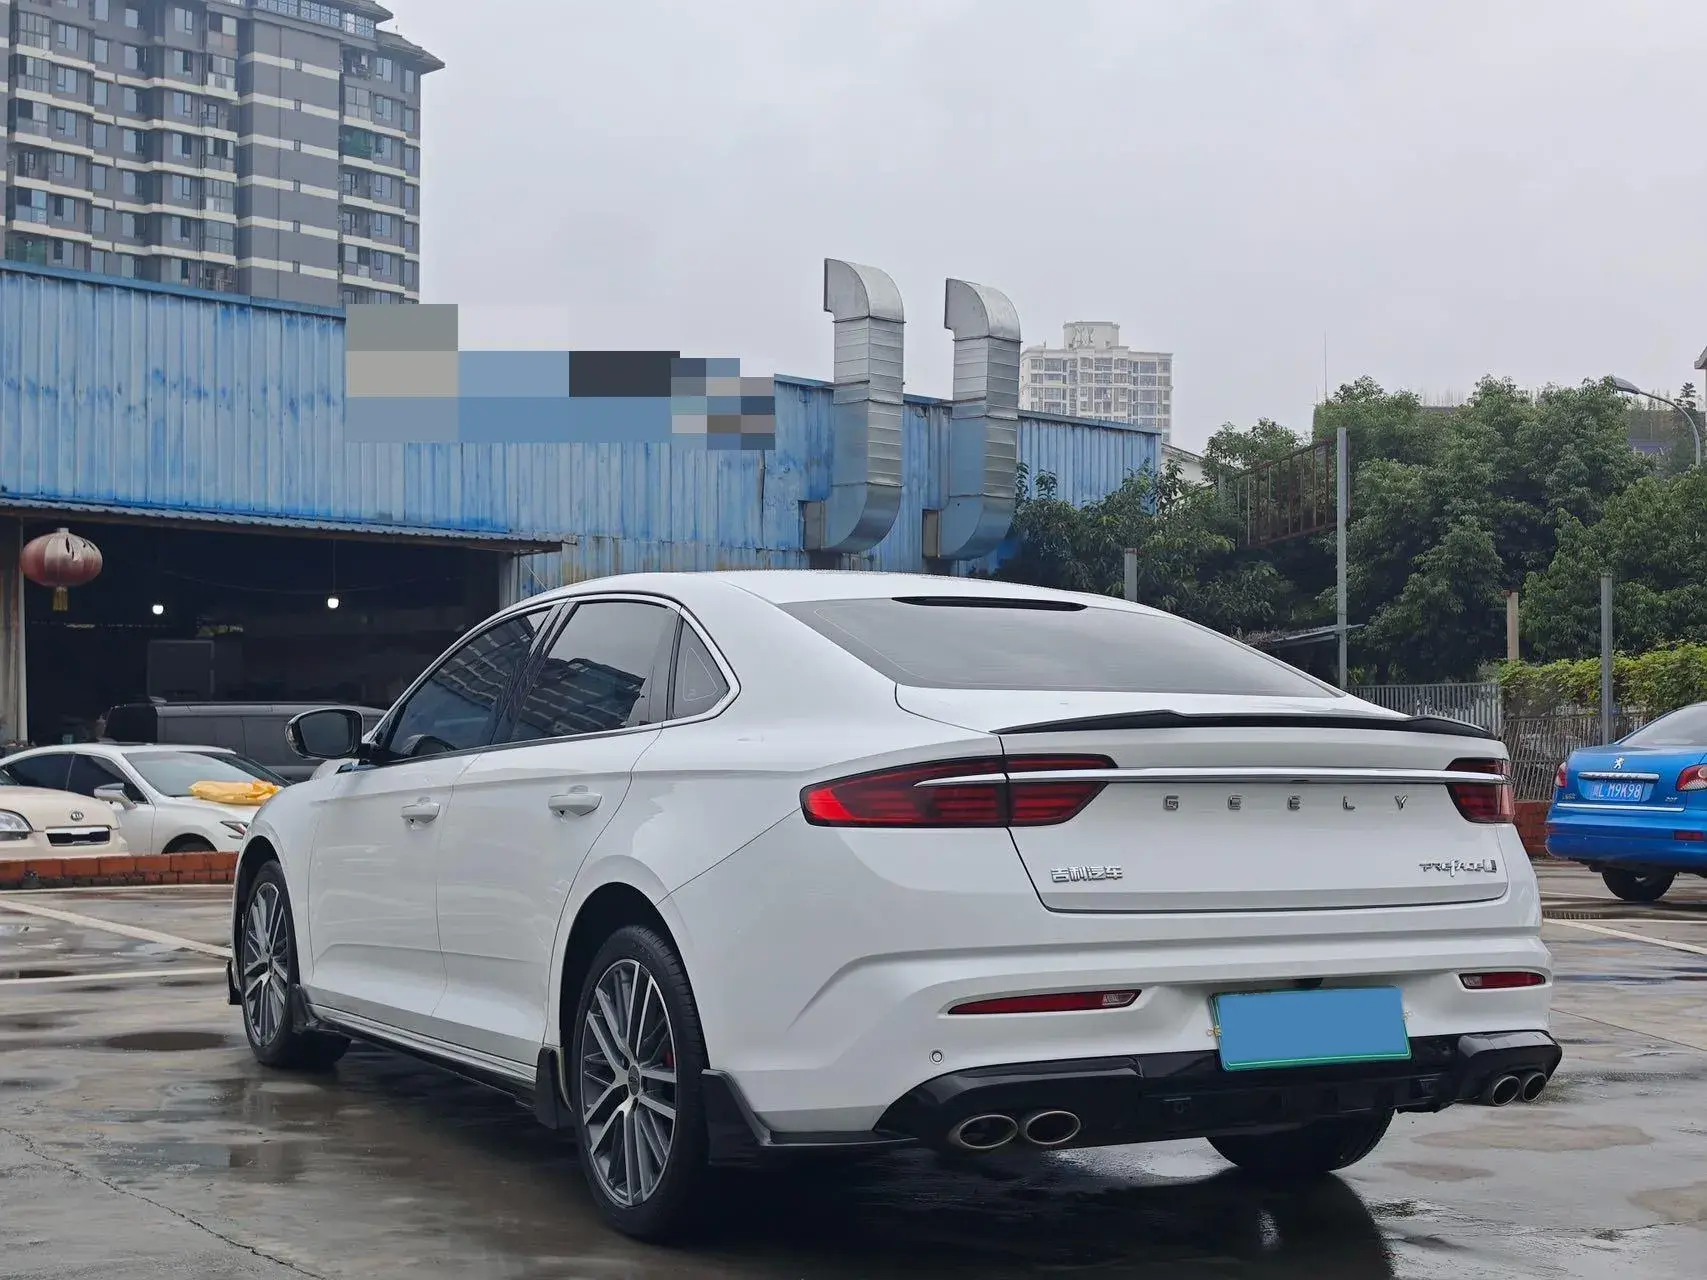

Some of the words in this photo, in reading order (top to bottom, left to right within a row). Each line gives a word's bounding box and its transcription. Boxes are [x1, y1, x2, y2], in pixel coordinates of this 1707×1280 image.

[1163, 795, 1408, 811] GEELY
[1050, 865, 1123, 883] 吉利汽车
